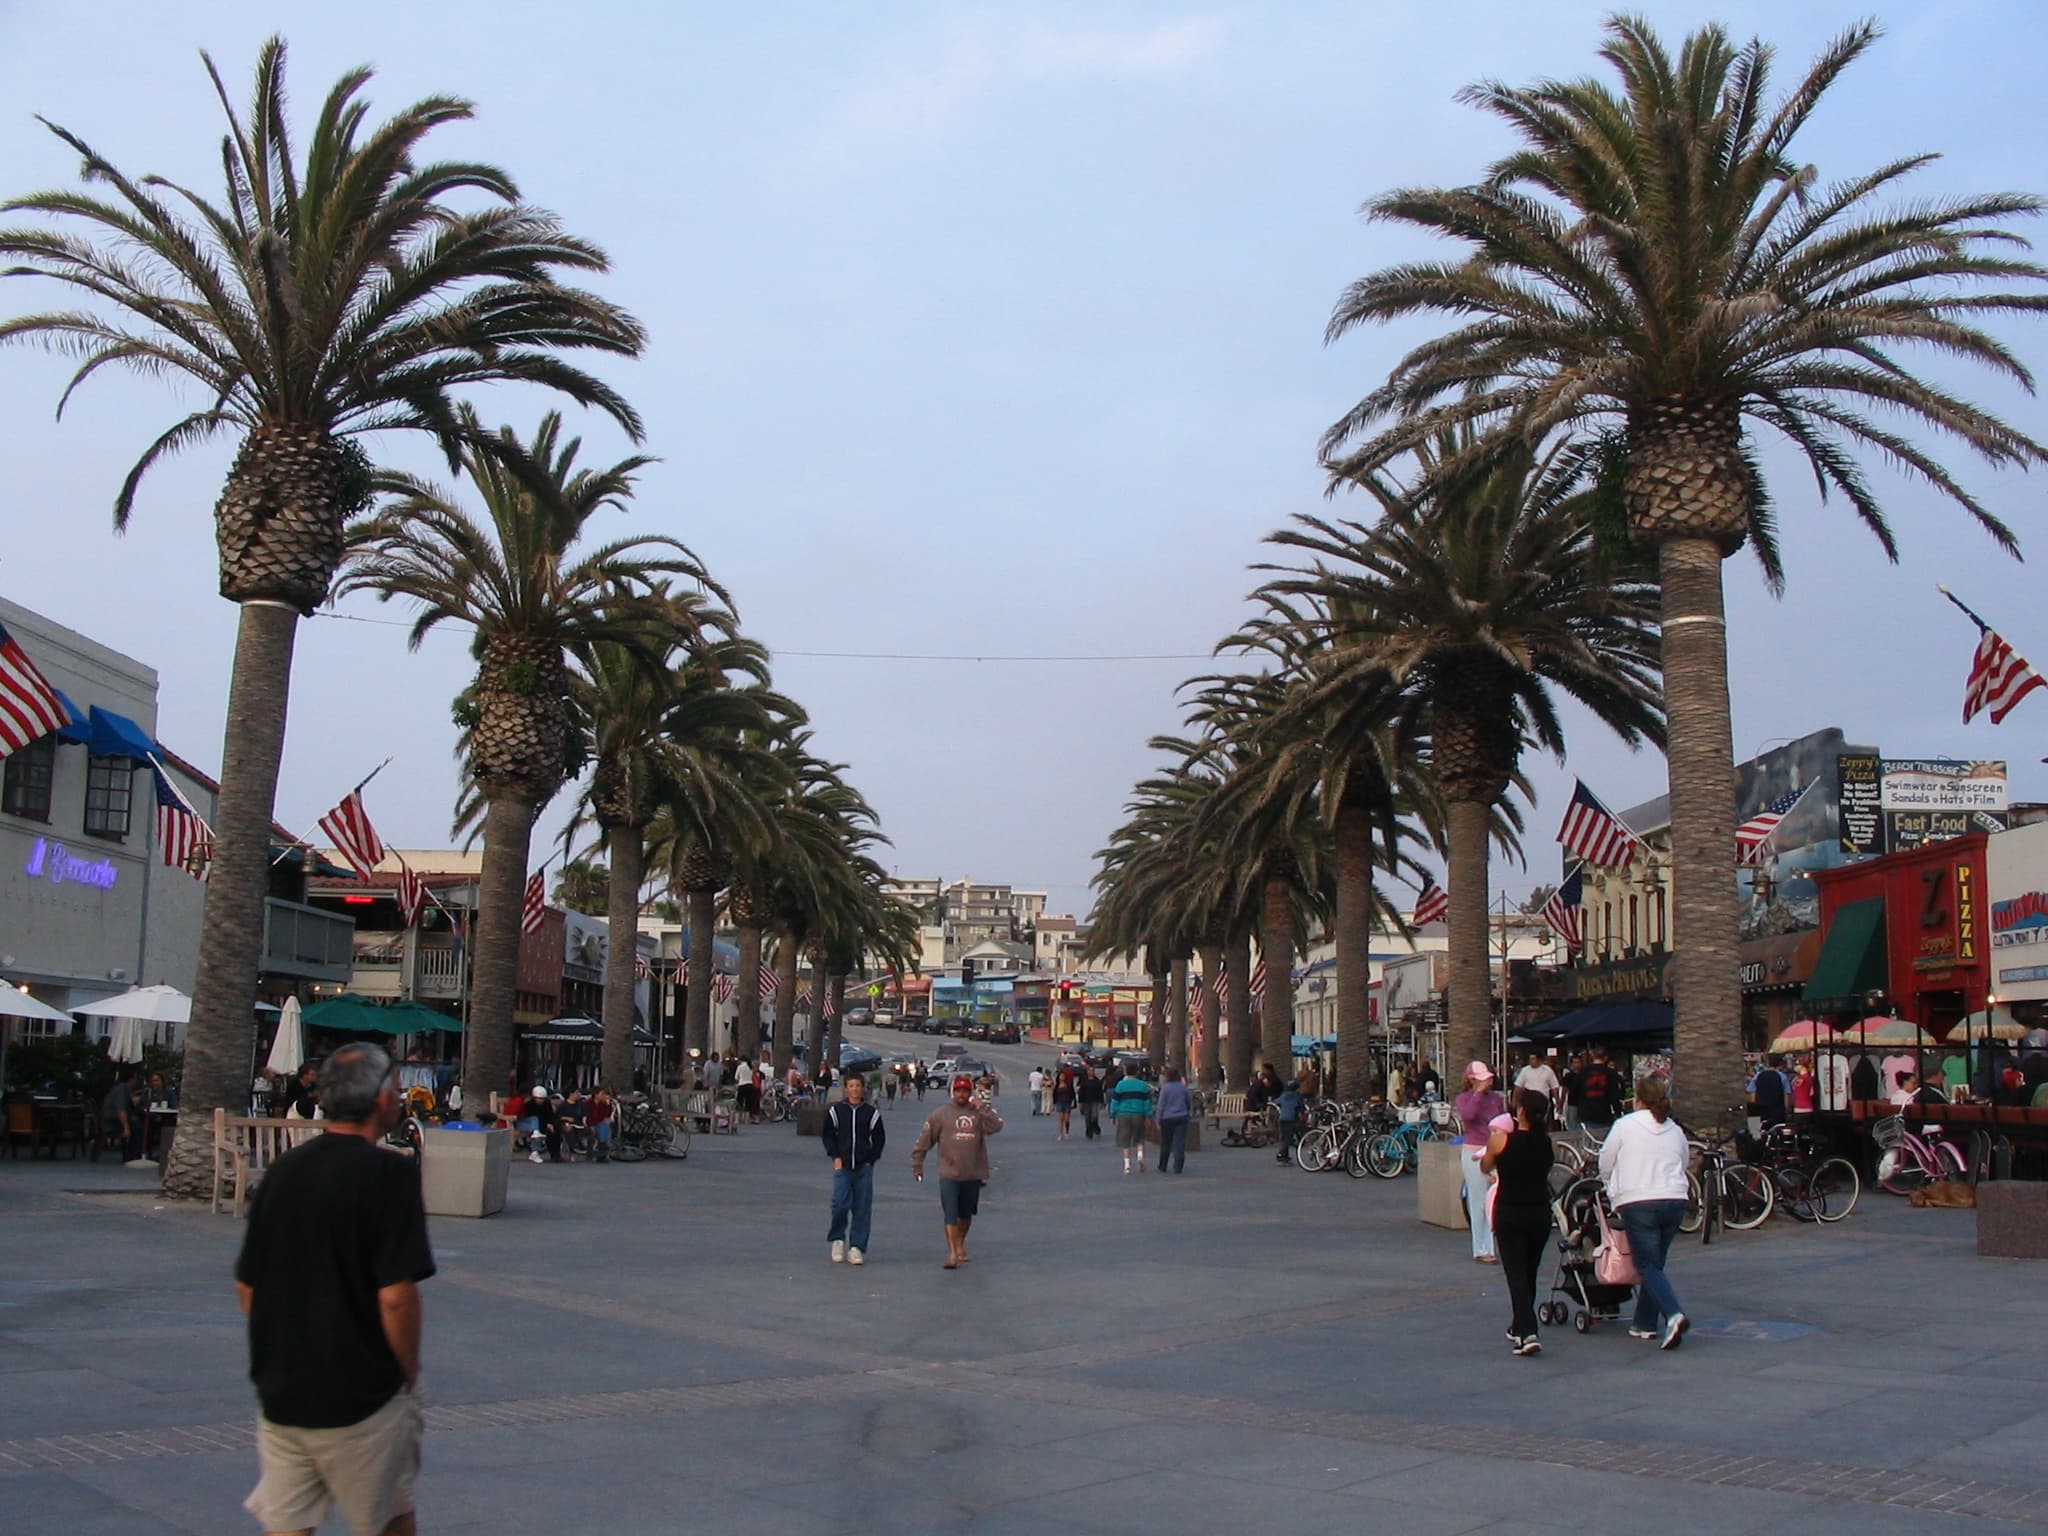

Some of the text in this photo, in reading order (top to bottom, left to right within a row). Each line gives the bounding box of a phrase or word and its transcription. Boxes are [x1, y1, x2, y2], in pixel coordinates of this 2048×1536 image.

[1840, 757, 1879, 769] Zeppy's
[1883, 762, 1914, 773] BEACH
[1844, 769, 1875, 780] Pizza
[1885, 780, 2003, 793] Swimwear Sunscreen
[1891, 793, 1996, 804] Sandals Hats Film
[1894, 813, 1968, 833] Fast Food
[1958, 866, 1974, 958] PIZZA
